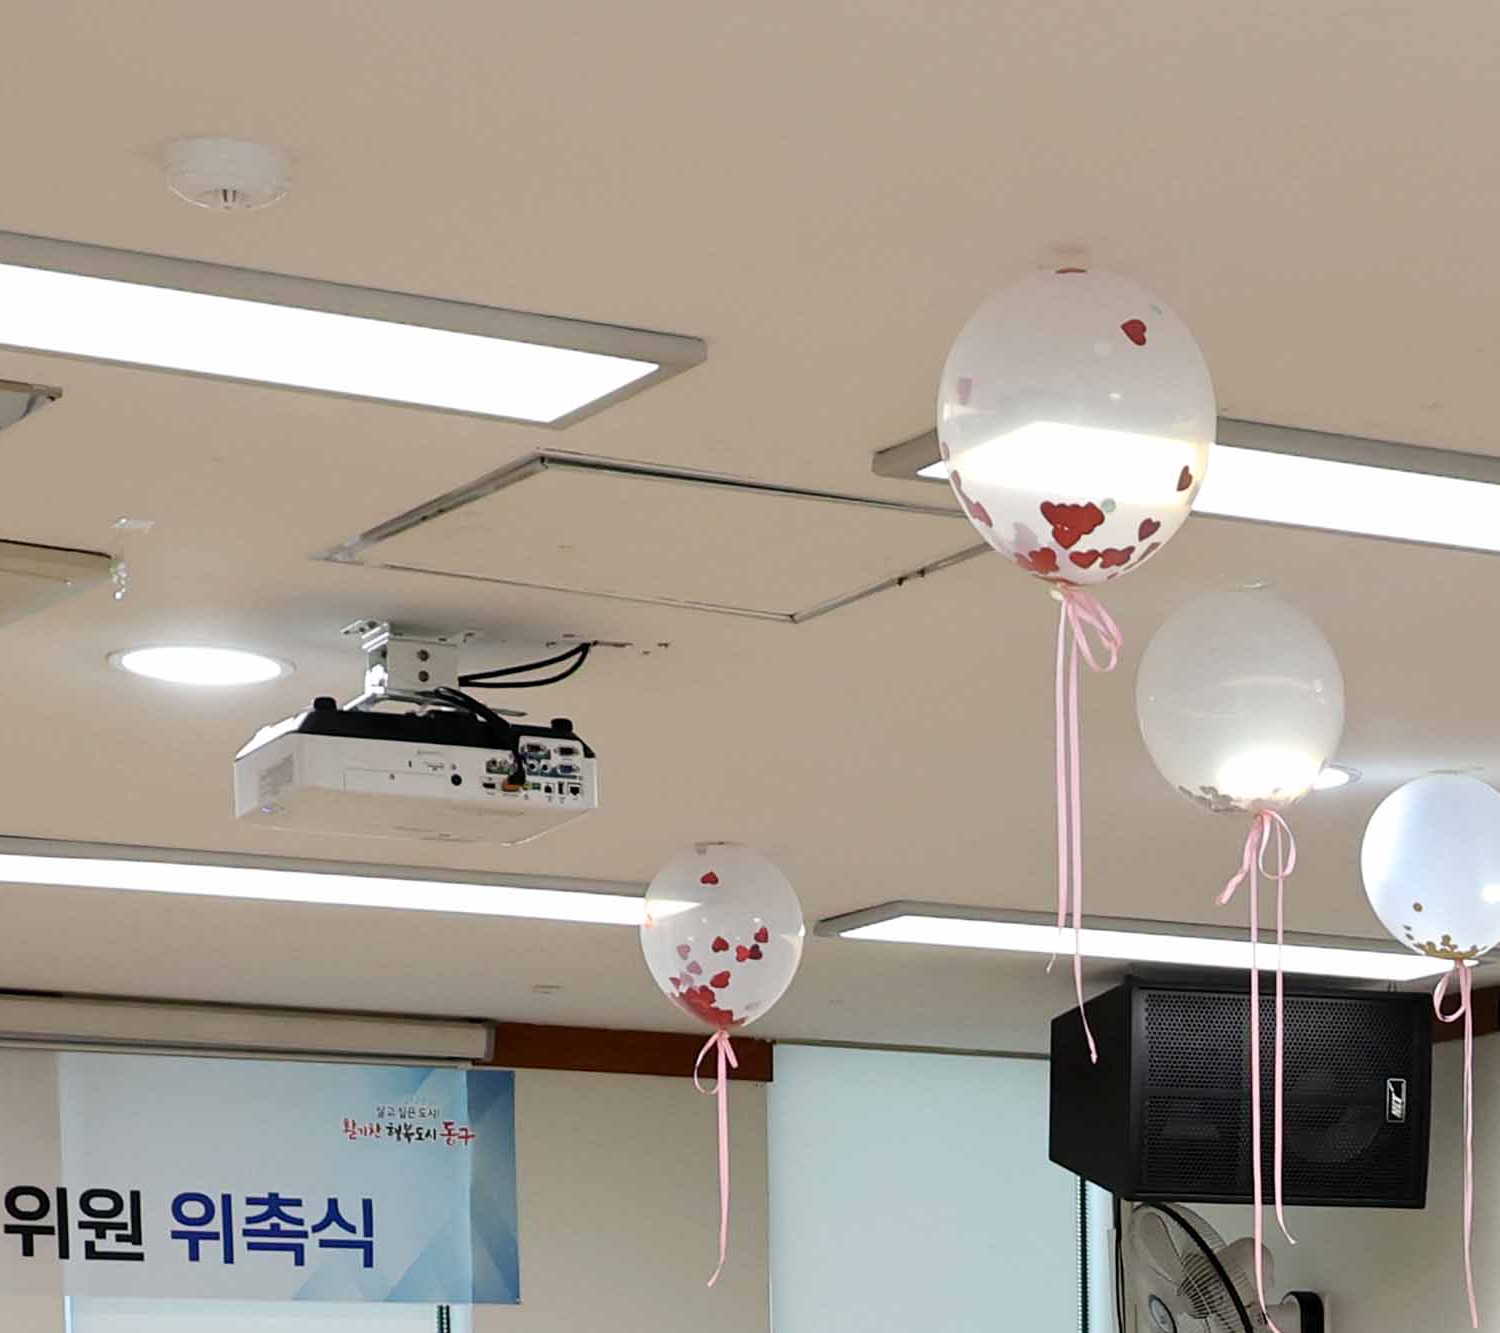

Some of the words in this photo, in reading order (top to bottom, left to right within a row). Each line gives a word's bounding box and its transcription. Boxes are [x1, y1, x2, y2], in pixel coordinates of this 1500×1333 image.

[439, 1119, 476, 1146] 동구
[3, 1184, 145, 1262] 위원
[170, 1191, 375, 1268] 위촉식
